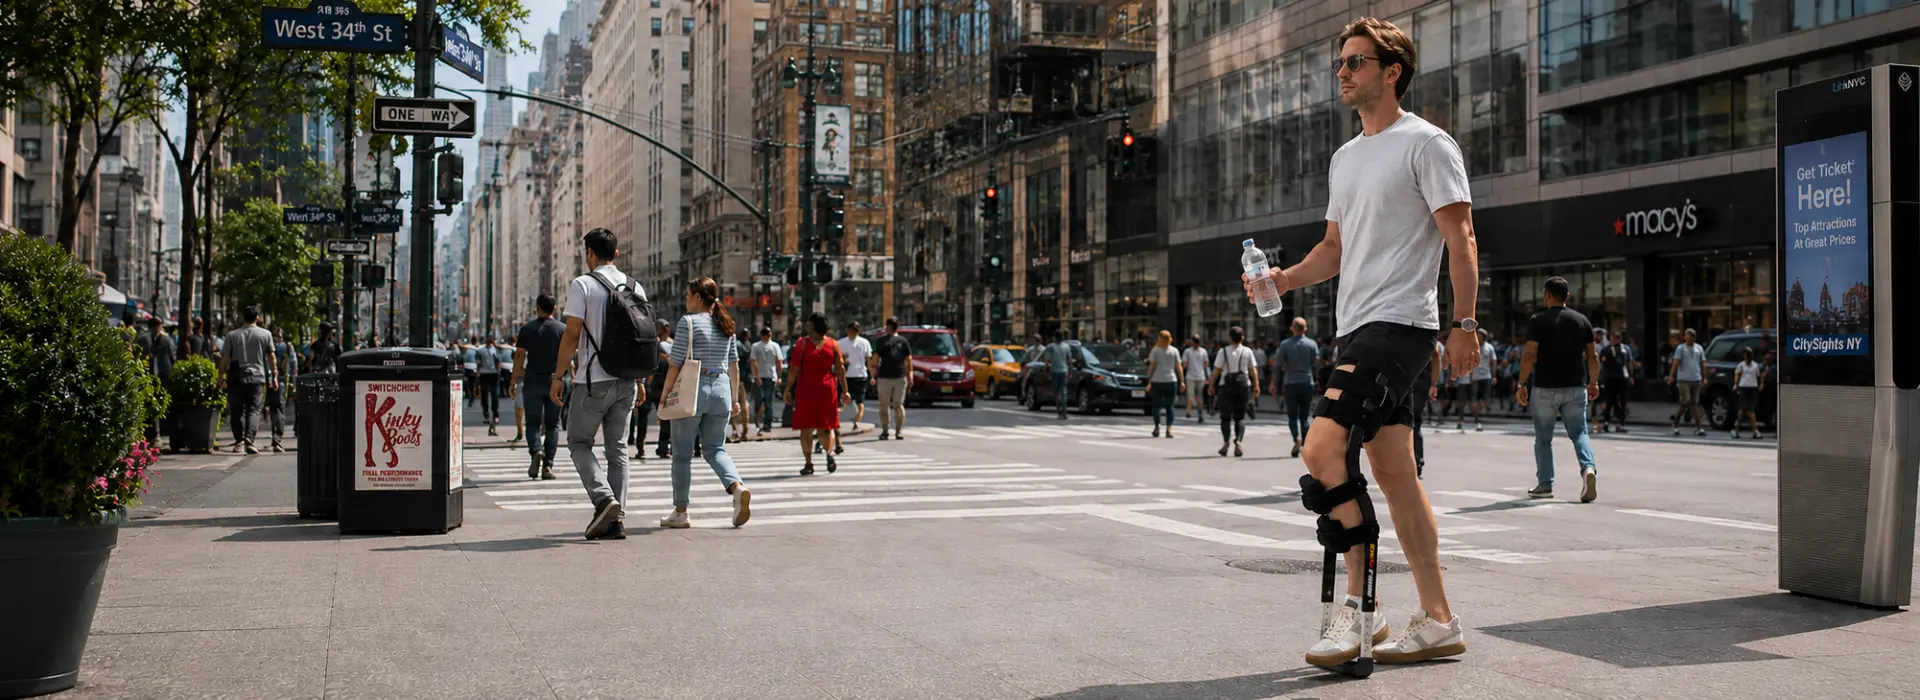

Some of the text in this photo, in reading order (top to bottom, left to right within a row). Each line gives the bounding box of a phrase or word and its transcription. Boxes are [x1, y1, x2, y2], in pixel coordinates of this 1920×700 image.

[274, 19, 393, 42] West 34th St
[1832, 76, 1866, 92] LinkNYC
[388, 108, 459, 125] ONE WAY
[1796, 166, 1816, 181] Get
[1797, 178, 1852, 211] Here!
[1626, 198, 1698, 238] macy's
[1793, 217, 1857, 235] Top Attractions
[1794, 233, 1857, 250] At Great Prices
[1792, 336, 1862, 353] CitySights NY
[386, 427, 423, 447] Boots
